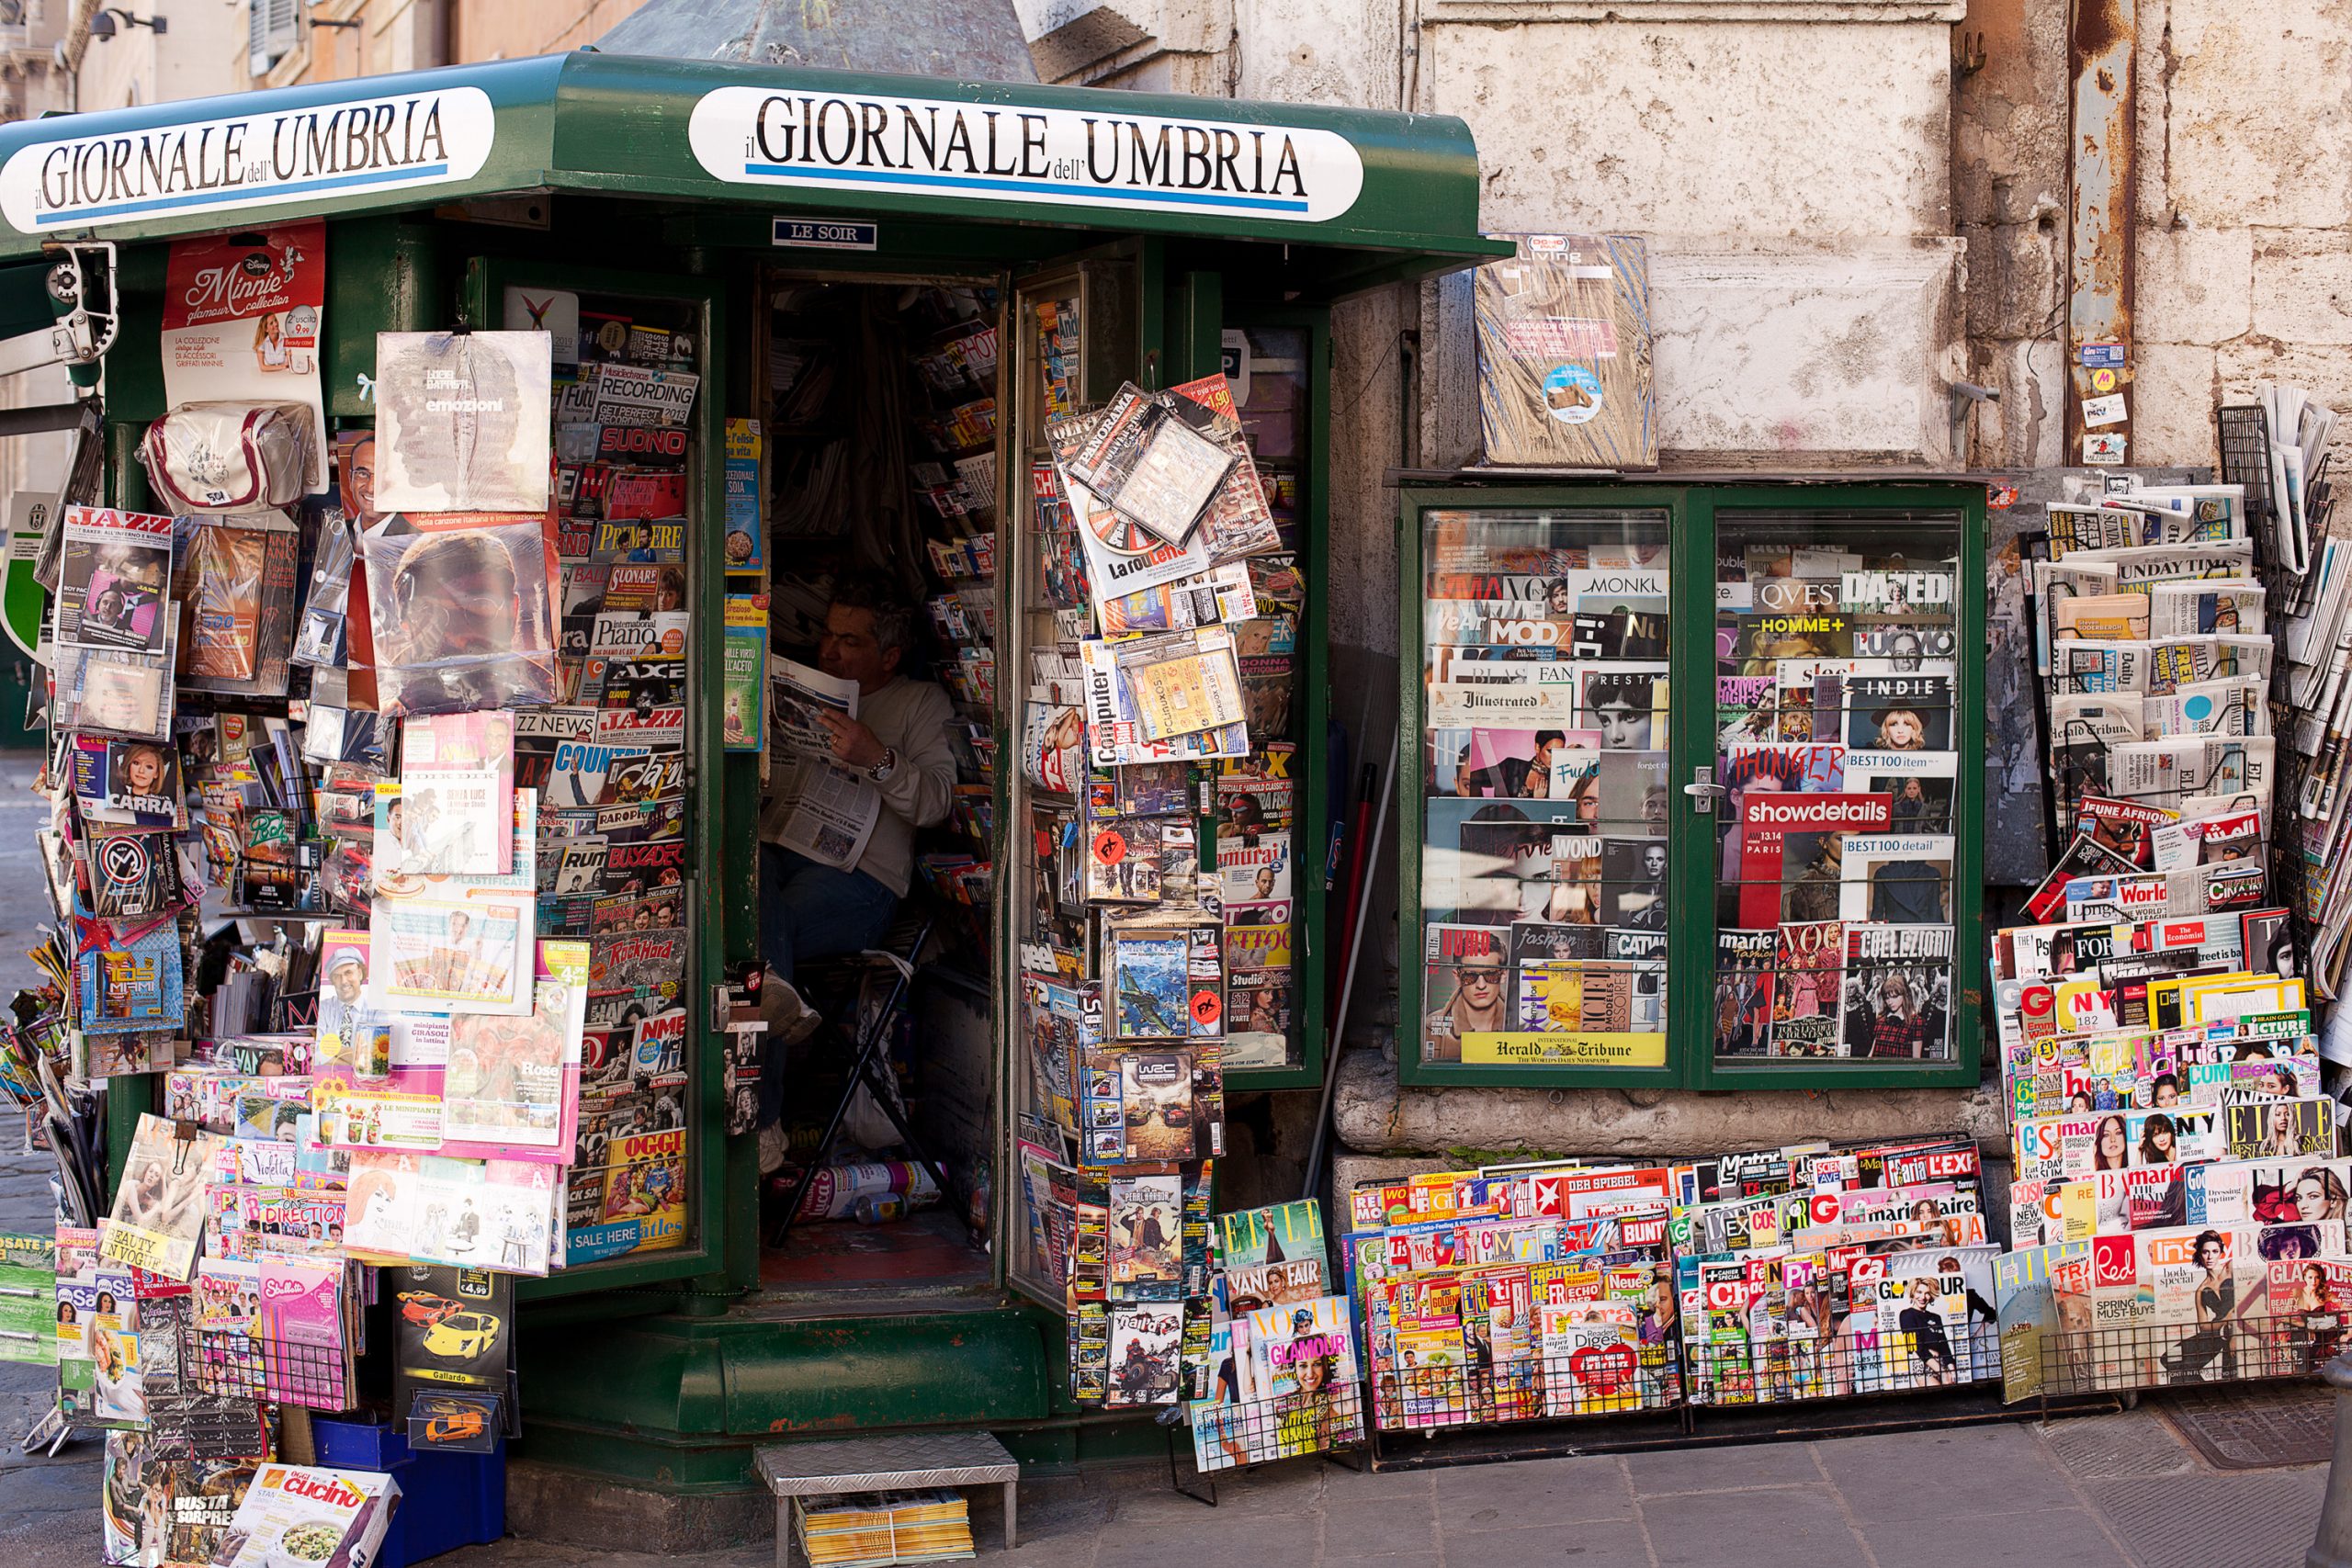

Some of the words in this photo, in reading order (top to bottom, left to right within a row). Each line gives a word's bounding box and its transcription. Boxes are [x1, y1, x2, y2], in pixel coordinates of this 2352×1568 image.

[36, 188, 42, 209] il
[41, 123, 249, 209] GIORNALE
[248, 160, 272, 184] dell'
[275, 97, 447, 181] UMBRIA
[745, 136, 754, 160] il
[756, 96, 1051, 179] GIORNALE
[1054, 158, 1088, 183] dell'
[1082, 118, 1308, 197] UMBRIA
[791, 225, 812, 238] LE
[818, 226, 858, 241] SOIR
[1520, 250, 1581, 263] Living
[186, 262, 283, 316] Minnie
[187, 306, 229, 326] glamour
[246, 294, 289, 311] collection
[556, 336, 572, 345] 2019
[601, 378, 693, 404] RECORDING
[425, 398, 503, 412] emozioni
[600, 404, 617, 414] GET
[618, 406, 659, 420] PERFECT
[664, 408, 687, 420] 2013
[1080, 392, 1135, 464] PANORAMA
[601, 428, 686, 455] SUONO
[729, 481, 744, 493] SOIA
[68, 508, 172, 536] JAZZ
[417, 518, 433, 526] della
[435, 517, 461, 525] canzone
[496, 513, 546, 522] internazionale
[147, 535, 171, 543] RITORNO
[2186, 557, 2243, 569] TIMES
[609, 568, 658, 592] SUONARE
[1842, 572, 1949, 604] DATED
[1761, 584, 1842, 609] QVEST
[614, 619, 657, 628] international
[2174, 645, 2190, 685] FREE
[1867, 681, 1934, 695] INDIE
[1463, 691, 1538, 708] Illustrated
[601, 709, 684, 731] JAZZ
[1098, 669, 1116, 763] Computer
[541, 717, 594, 735] NEWS
[1638, 762, 1656, 771] forget
[1736, 747, 1846, 782] HUNGER
[1850, 755, 1879, 767] BEST
[1882, 755, 1901, 767] 100
[1903, 757, 1927, 767] item
[470, 789, 485, 800] LUCE
[1748, 801, 1886, 823] showdetails
[2082, 803, 2120, 818] JEUNE
[2123, 807, 2173, 822] AFRIQU
[1761, 831, 1781, 840] 13.14
[1747, 845, 1781, 853] PARIS
[1848, 841, 1877, 852] BEST
[1880, 840, 1899, 852] 100
[1903, 840, 1933, 851] detail
[454, 876, 529, 886] PLASTIFICATE
[2120, 885, 2167, 904] World
[2166, 930, 2204, 942] Economist
[2179, 927, 2191, 935] The
[1720, 932, 1771, 950] marie
[1860, 931, 1948, 958] COLLEZIONI
[2113, 955, 2143, 964] MILLENNIAL
[110, 967, 155, 982] 105
[1232, 975, 1263, 987] Studio
[110, 981, 155, 993] MIAMI
[1230, 1013, 1250, 1023] D'ARTE
[2078, 1015, 2098, 1026] 182
[412, 1030, 448, 1038] GIRASOLI
[642, 1015, 685, 1043] NME
[1497, 1042, 1543, 1057] Herald
[1577, 1042, 1632, 1056] Tribune
[2039, 1042, 2055, 1056] £1
[521, 1062, 559, 1077] Rose
[2116, 1067, 2133, 1077] PLUS
[2233, 1060, 2273, 1077] teen
[395, 1106, 442, 1115] MINIPIANTE
[625, 1131, 682, 1157] OGGI
[2065, 1141, 2090, 1149] SPRING!
[2039, 1160, 2063, 1170] 7-DAY
[2041, 1168, 2063, 1179] SLIM
[2128, 1163, 2185, 1186] marie
[1568, 1179, 1592, 1192] DER
[1593, 1175, 1639, 1190] SPIEGEL
[2208, 1187, 2241, 1196] Dressing
[283, 1199, 308, 1210] ONE
[1427, 1211, 1450, 1220] FARBE!
[2014, 1217, 2042, 1227] ORGASM
[2016, 1211, 2039, 1222] NEW
[1222, 1198, 1323, 1253] ELLE
[1421, 1223, 1453, 1232] Deko-Feeling
[107, 1230, 156, 1254] BEAUTY
[575, 1228, 603, 1247] SALE
[606, 1225, 637, 1242] HERE
[101, 1243, 118, 1257] IN
[119, 1246, 162, 1267] VOGUE
[2095, 1246, 2136, 1284] Red
[1718, 1269, 1738, 1278] CAHIER
[2160, 1275, 2195, 1285] special
[2163, 1268, 2188, 1279] body
[200, 1275, 240, 1294] DOLLY
[1609, 1274, 1641, 1289] Neue
[1568, 1286, 1599, 1296] ECHO
[1611, 1290, 1645, 1306] Post
[2097, 1298, 2134, 1311] SPRING
[2097, 1304, 2156, 1319] MUST-BUYS
[1544, 1304, 1633, 1334] petra
[1576, 1334, 1625, 1350] Digest
[1270, 1334, 1347, 1366] GLAMOUR
[433, 1371, 466, 1382] Gallardo
[290, 1471, 311, 1480] OGGI
[175, 1495, 229, 1510] BUSTA
